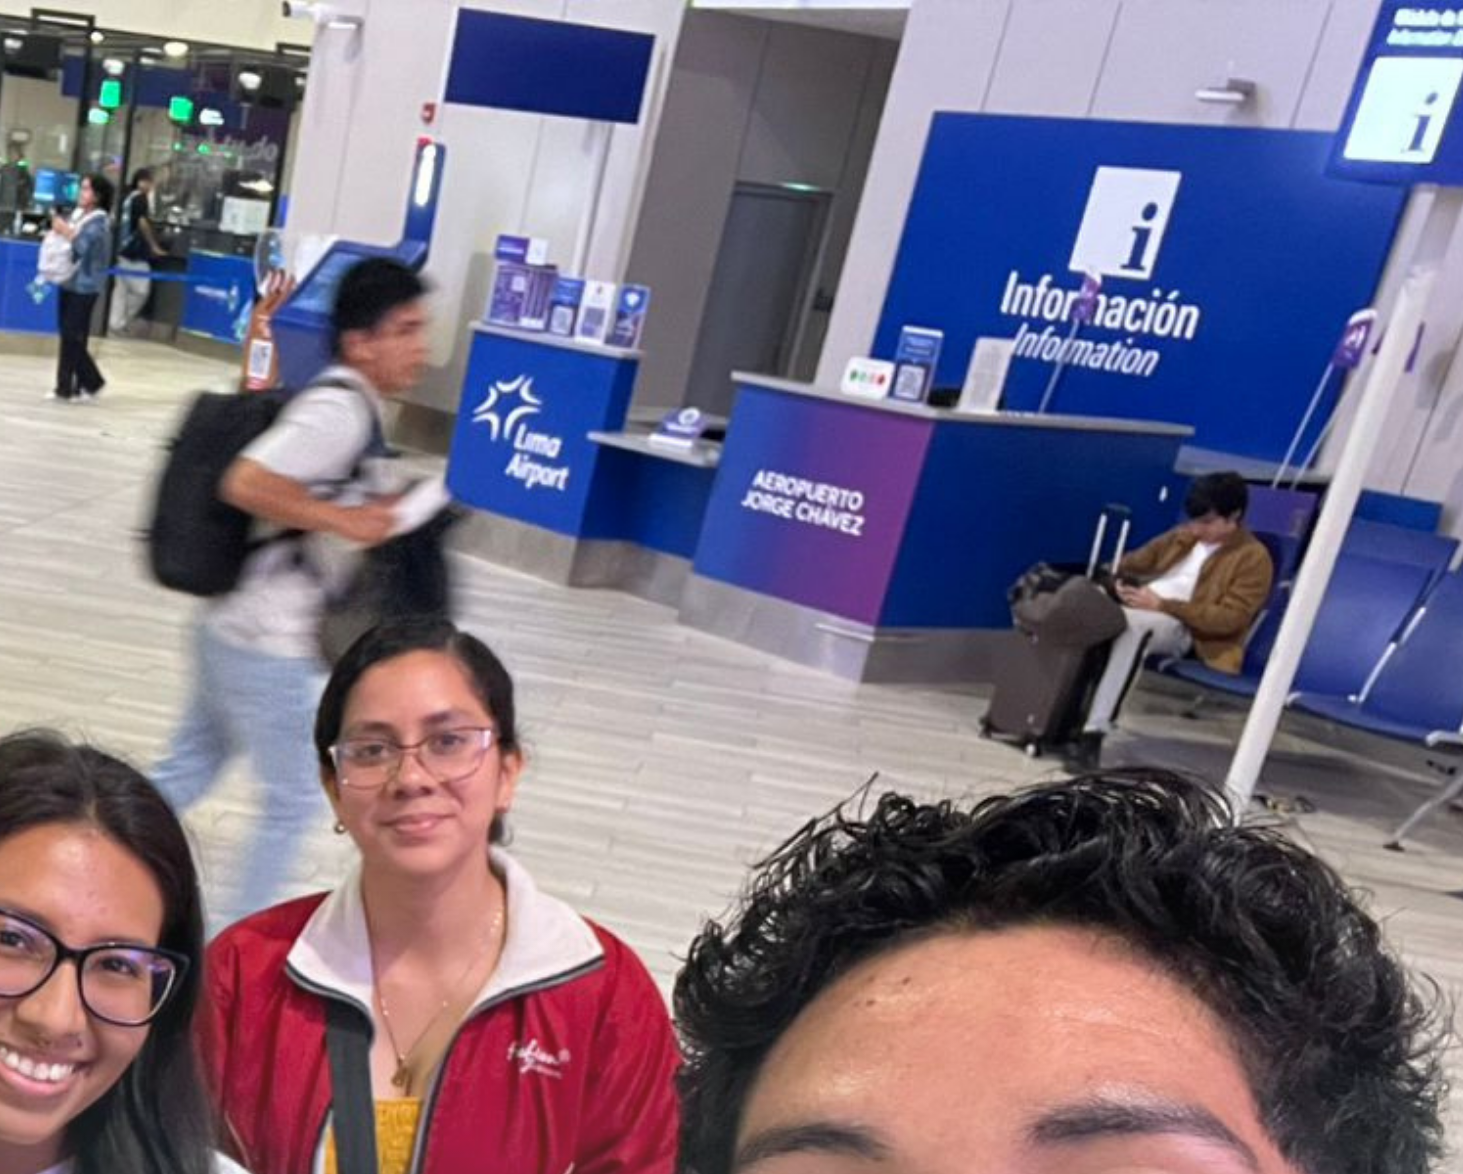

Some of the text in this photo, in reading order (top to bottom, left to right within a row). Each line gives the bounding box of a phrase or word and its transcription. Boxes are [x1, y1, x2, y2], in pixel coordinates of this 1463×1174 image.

[1012, 322, 1160, 377] Information
[514, 423, 562, 458] Lima
[505, 453, 570, 491] Airport
[752, 470, 863, 511] AEROPUERTO
[741, 491, 795, 519] JORGE
